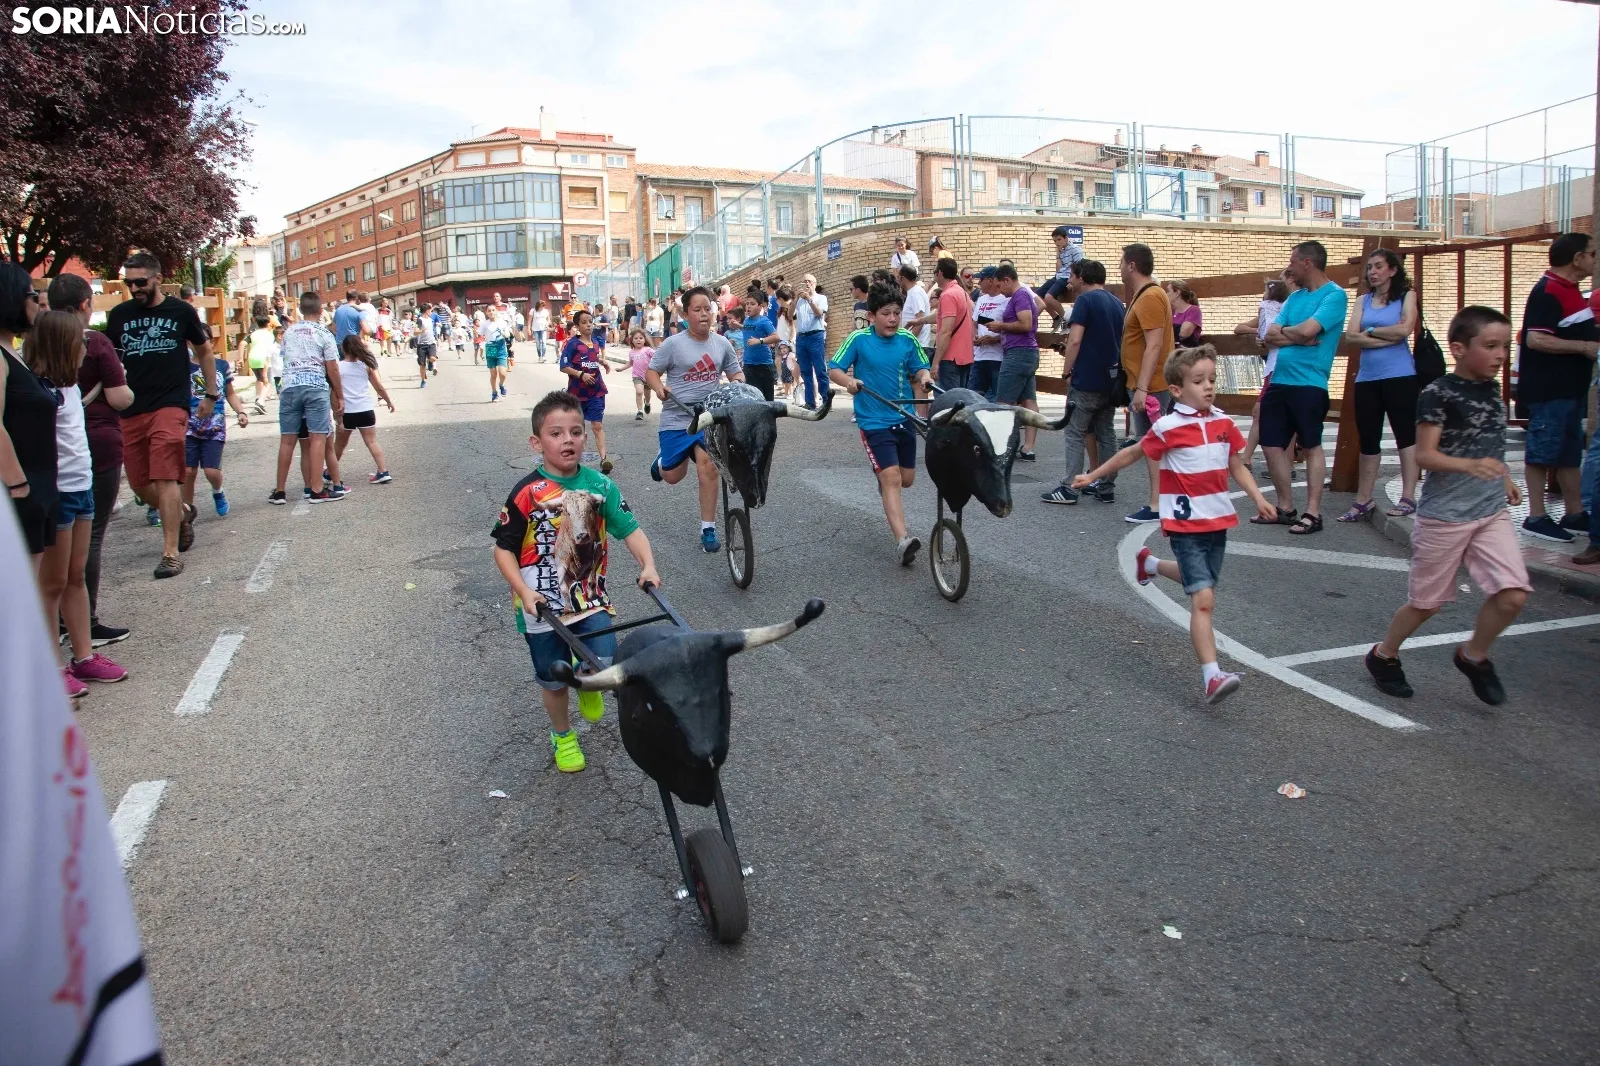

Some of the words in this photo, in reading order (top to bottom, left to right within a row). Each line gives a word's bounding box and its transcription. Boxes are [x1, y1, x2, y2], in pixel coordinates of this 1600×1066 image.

[123, 317, 178, 332] ORIGINAL
[120, 333, 178, 356] Confusion
[683, 371, 719, 382] adidas
[1173, 496, 1192, 521] 3
